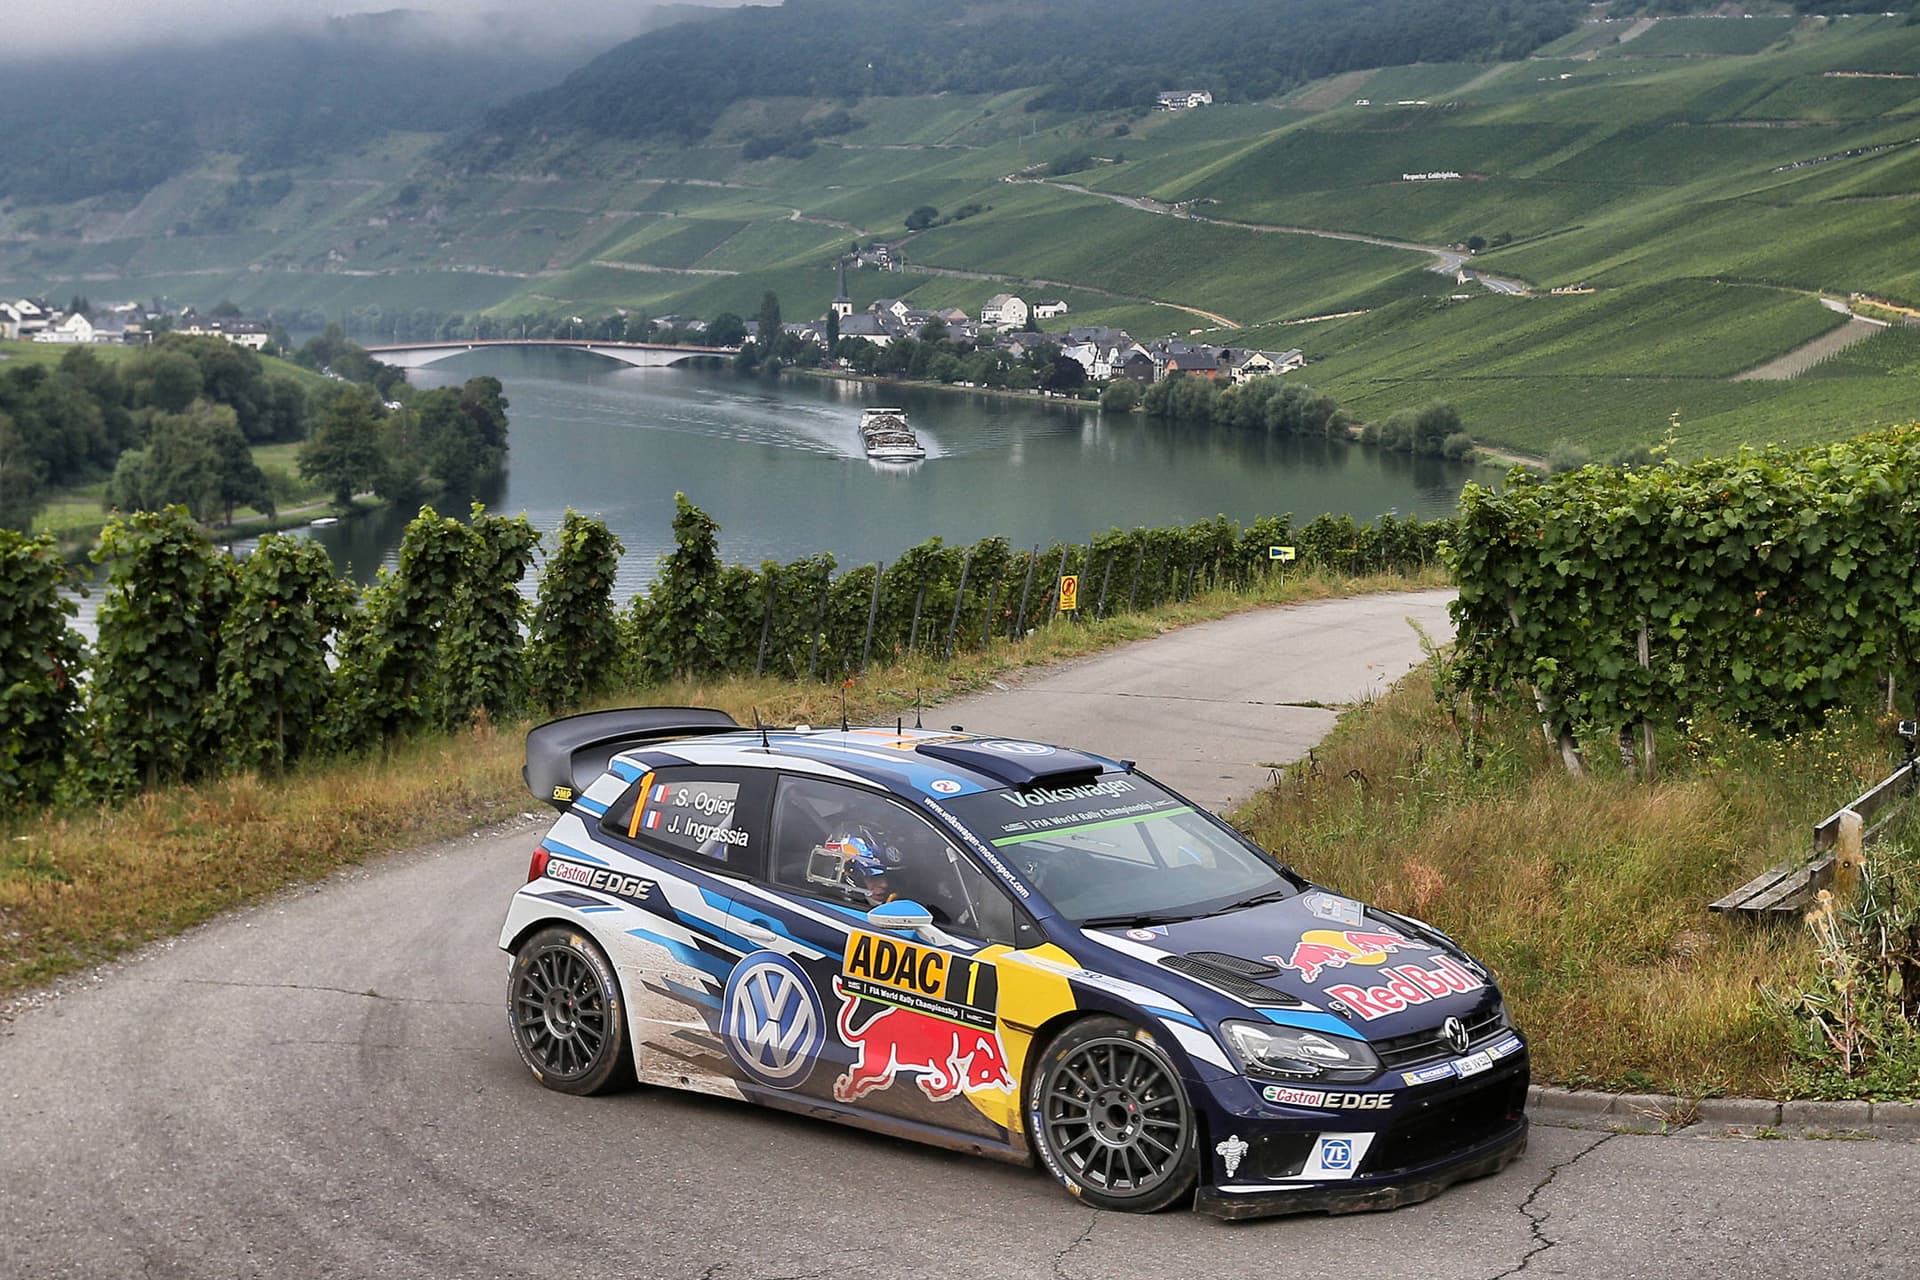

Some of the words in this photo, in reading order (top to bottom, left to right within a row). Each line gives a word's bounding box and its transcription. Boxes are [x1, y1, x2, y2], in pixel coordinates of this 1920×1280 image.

[553, 787, 572, 800] OMP
[628, 771, 656, 839] 1
[676, 789, 689, 808] S.
[694, 792, 735, 816] Ogier
[1000, 779, 1137, 808] Volkswagen
[667, 815, 680, 833] J.
[684, 817, 749, 847] Ingrassia
[1031, 817, 1051, 829] FIA
[1052, 813, 1081, 826] World
[1079, 808, 1103, 822] Rally
[1100, 802, 1154, 816] Championship
[924, 797, 1030, 898] www.volkswagen-motorsport.com
[556, 863, 591, 886] Castrol
[591, 870, 656, 900] EDGE
[848, 935, 943, 994] ADAC
[966, 962, 981, 1006] 1
[1323, 967, 1433, 1022] Red
[1392, 955, 1485, 999] Bull
[869, 986, 880, 996] FIA
[880, 989, 898, 1001] World
[899, 994, 915, 1007] Rally
[915, 996, 959, 1018] Championship
[1276, 1089, 1320, 1105] Castrol
[1323, 1092, 1395, 1109] EDGE
[1325, 1145, 1348, 1163] ZF
